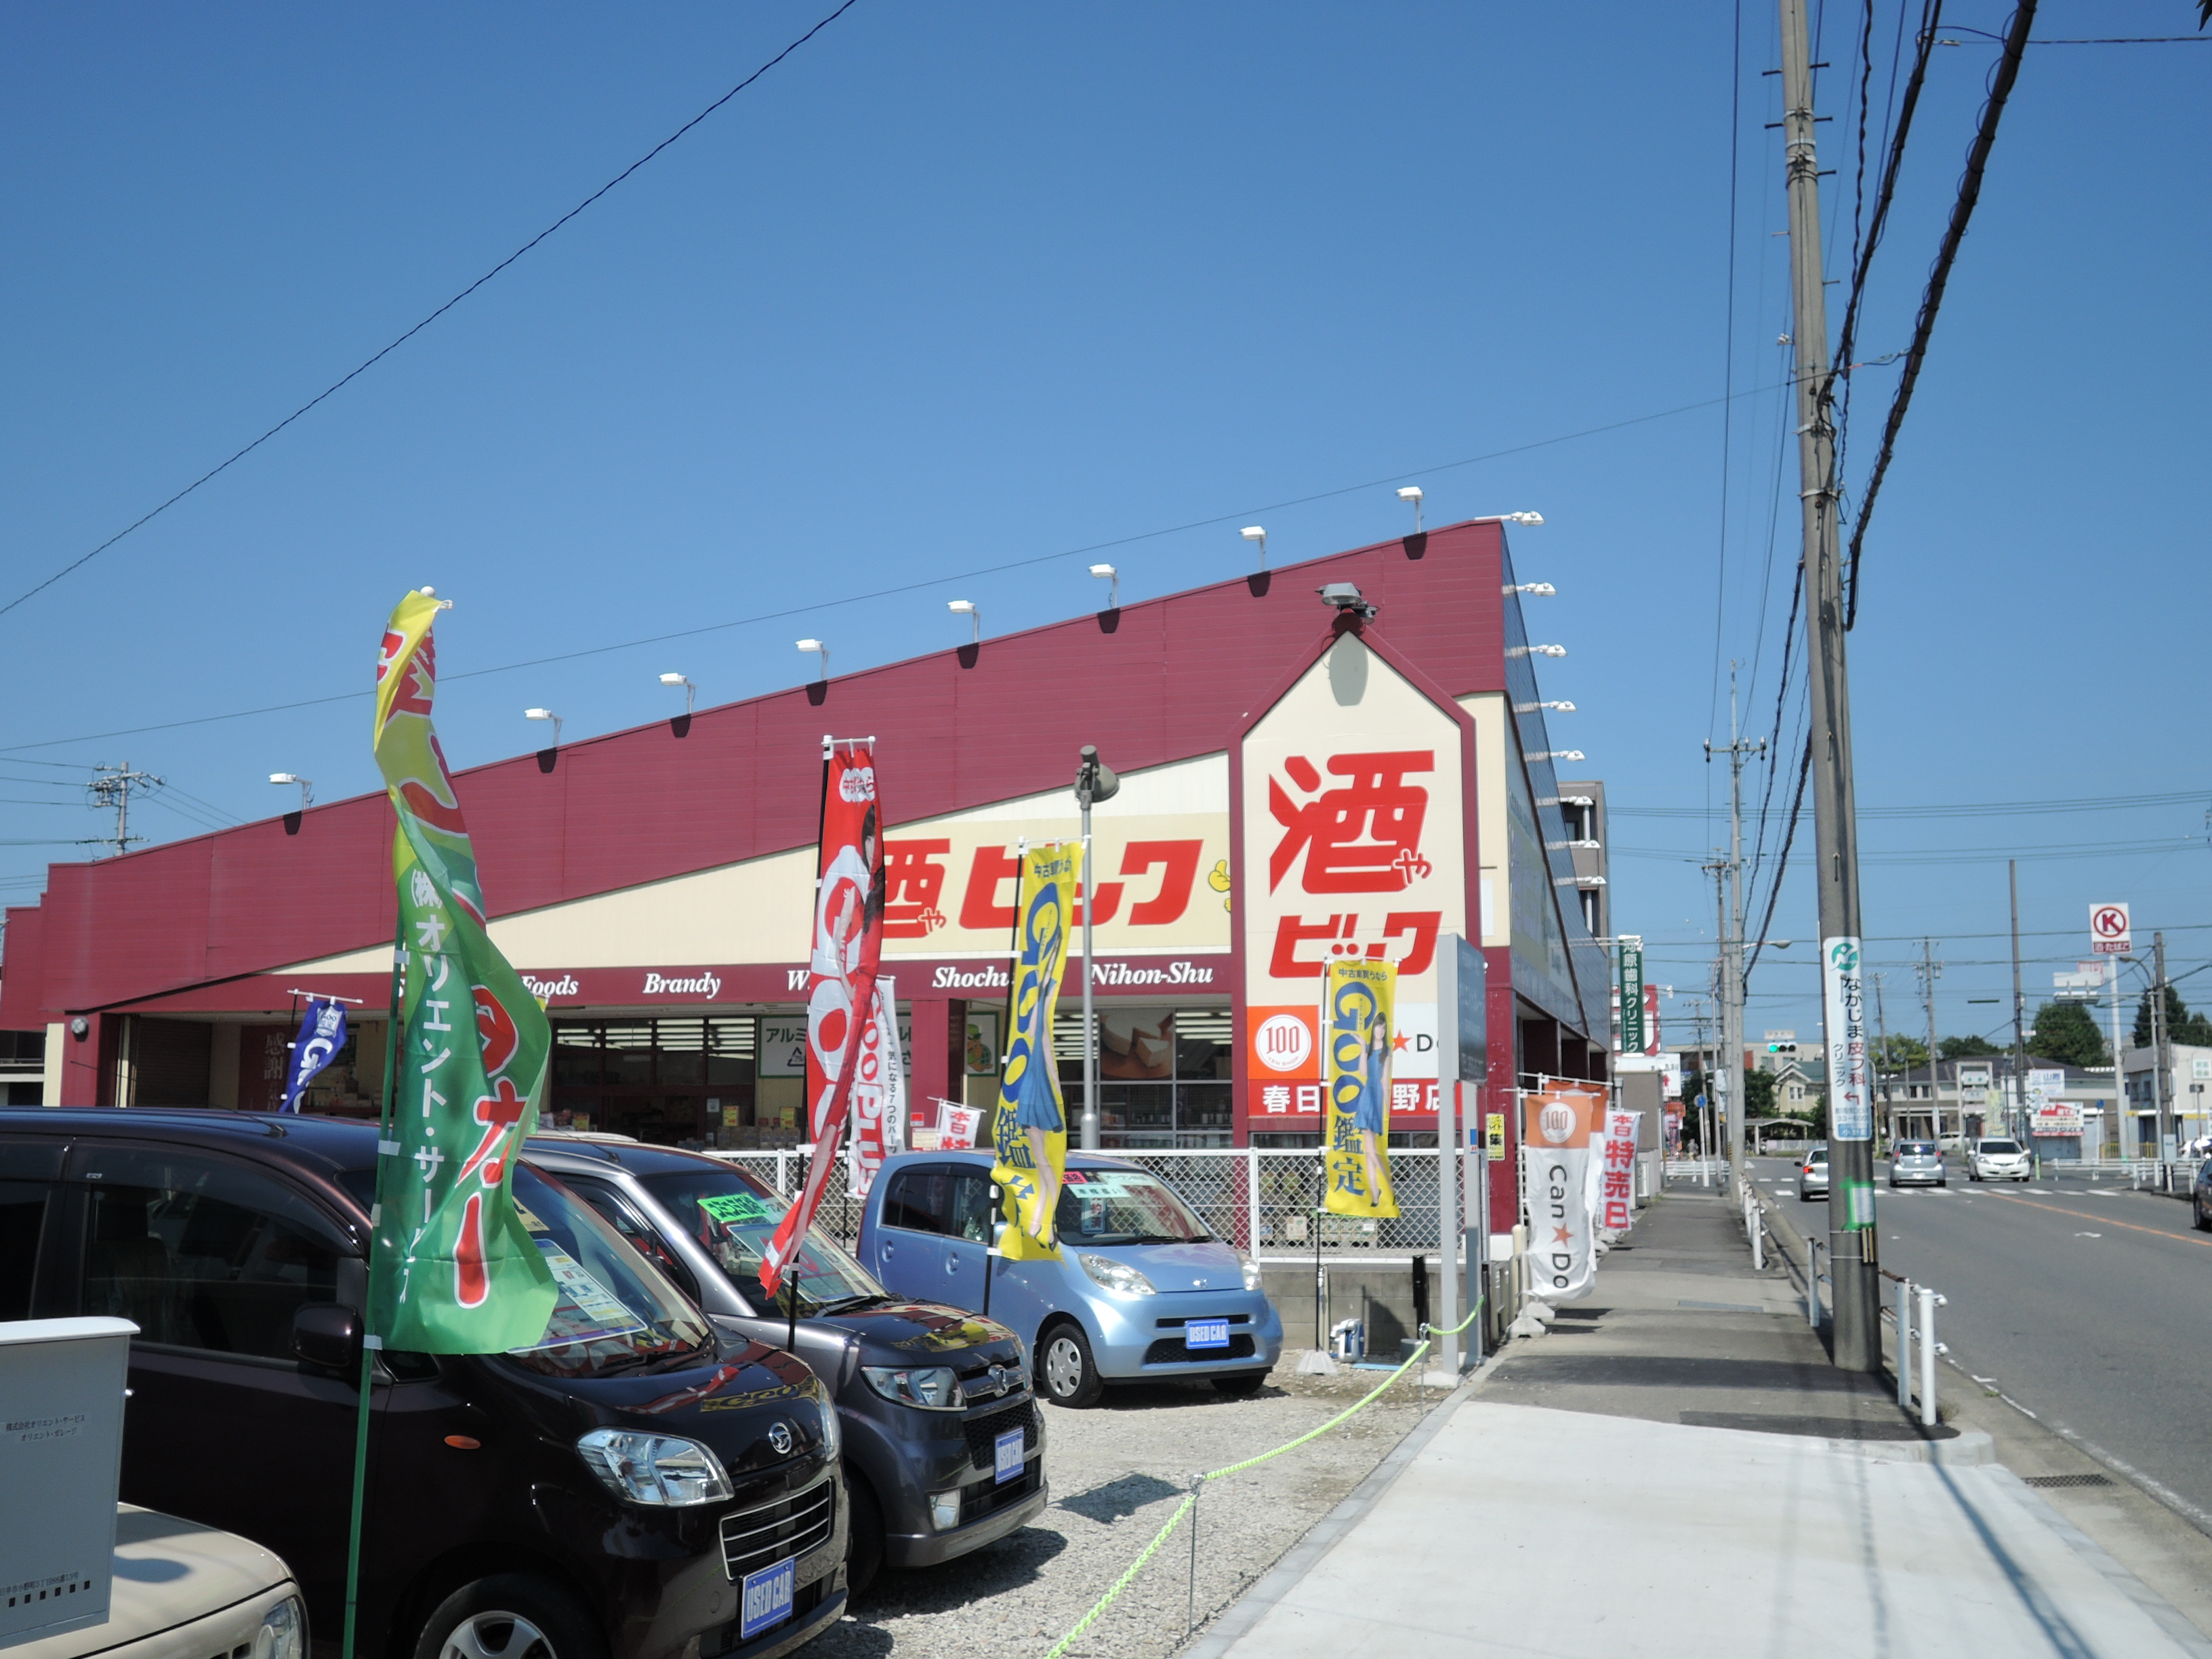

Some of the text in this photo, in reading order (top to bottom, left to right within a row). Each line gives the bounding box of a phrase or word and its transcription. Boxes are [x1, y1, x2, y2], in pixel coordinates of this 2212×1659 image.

[1269, 750, 1435, 897] 酒や
[1269, 911, 1442, 978] ビック
[523, 975, 579, 996] Foods
[643, 972, 721, 998] Brandy
[1091, 962, 1213, 985] Nihon-Shu
[1338, 969, 1388, 981] 中古車買うなら
[1266, 1025, 1300, 1054] 100
[1416, 1034, 1439, 1052] D
[1843, 977, 1866, 1086] なかじま皮フ科
[1833, 1043, 1846, 1087] クリニック
[1549, 1164, 1572, 1288] Can Do
[1189, 1325, 1227, 1343] USED CAR
[997, 1439, 1023, 1472] USED CAR
[747, 1570, 792, 1622] USED CAR
